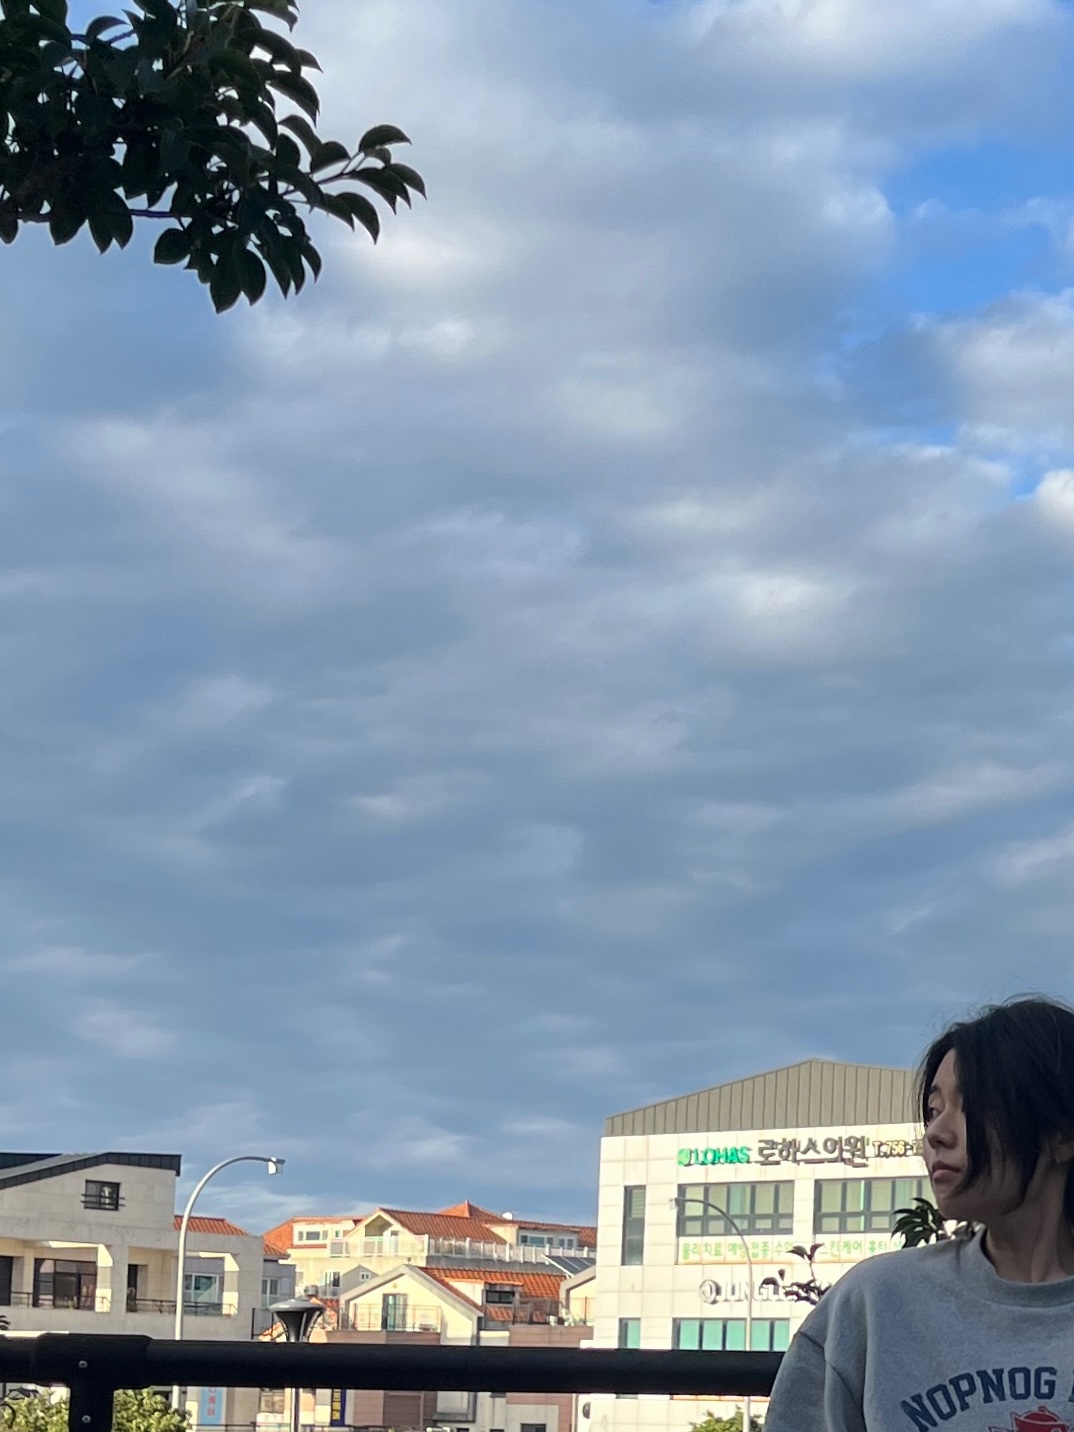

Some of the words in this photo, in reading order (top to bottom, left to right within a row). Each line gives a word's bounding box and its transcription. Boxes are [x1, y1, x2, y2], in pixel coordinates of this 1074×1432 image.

[691, 1145, 750, 1164] LOHAS
[757, 1135, 868, 1168] 로하스의원
[872, 1140, 923, 1158] T.756-7
